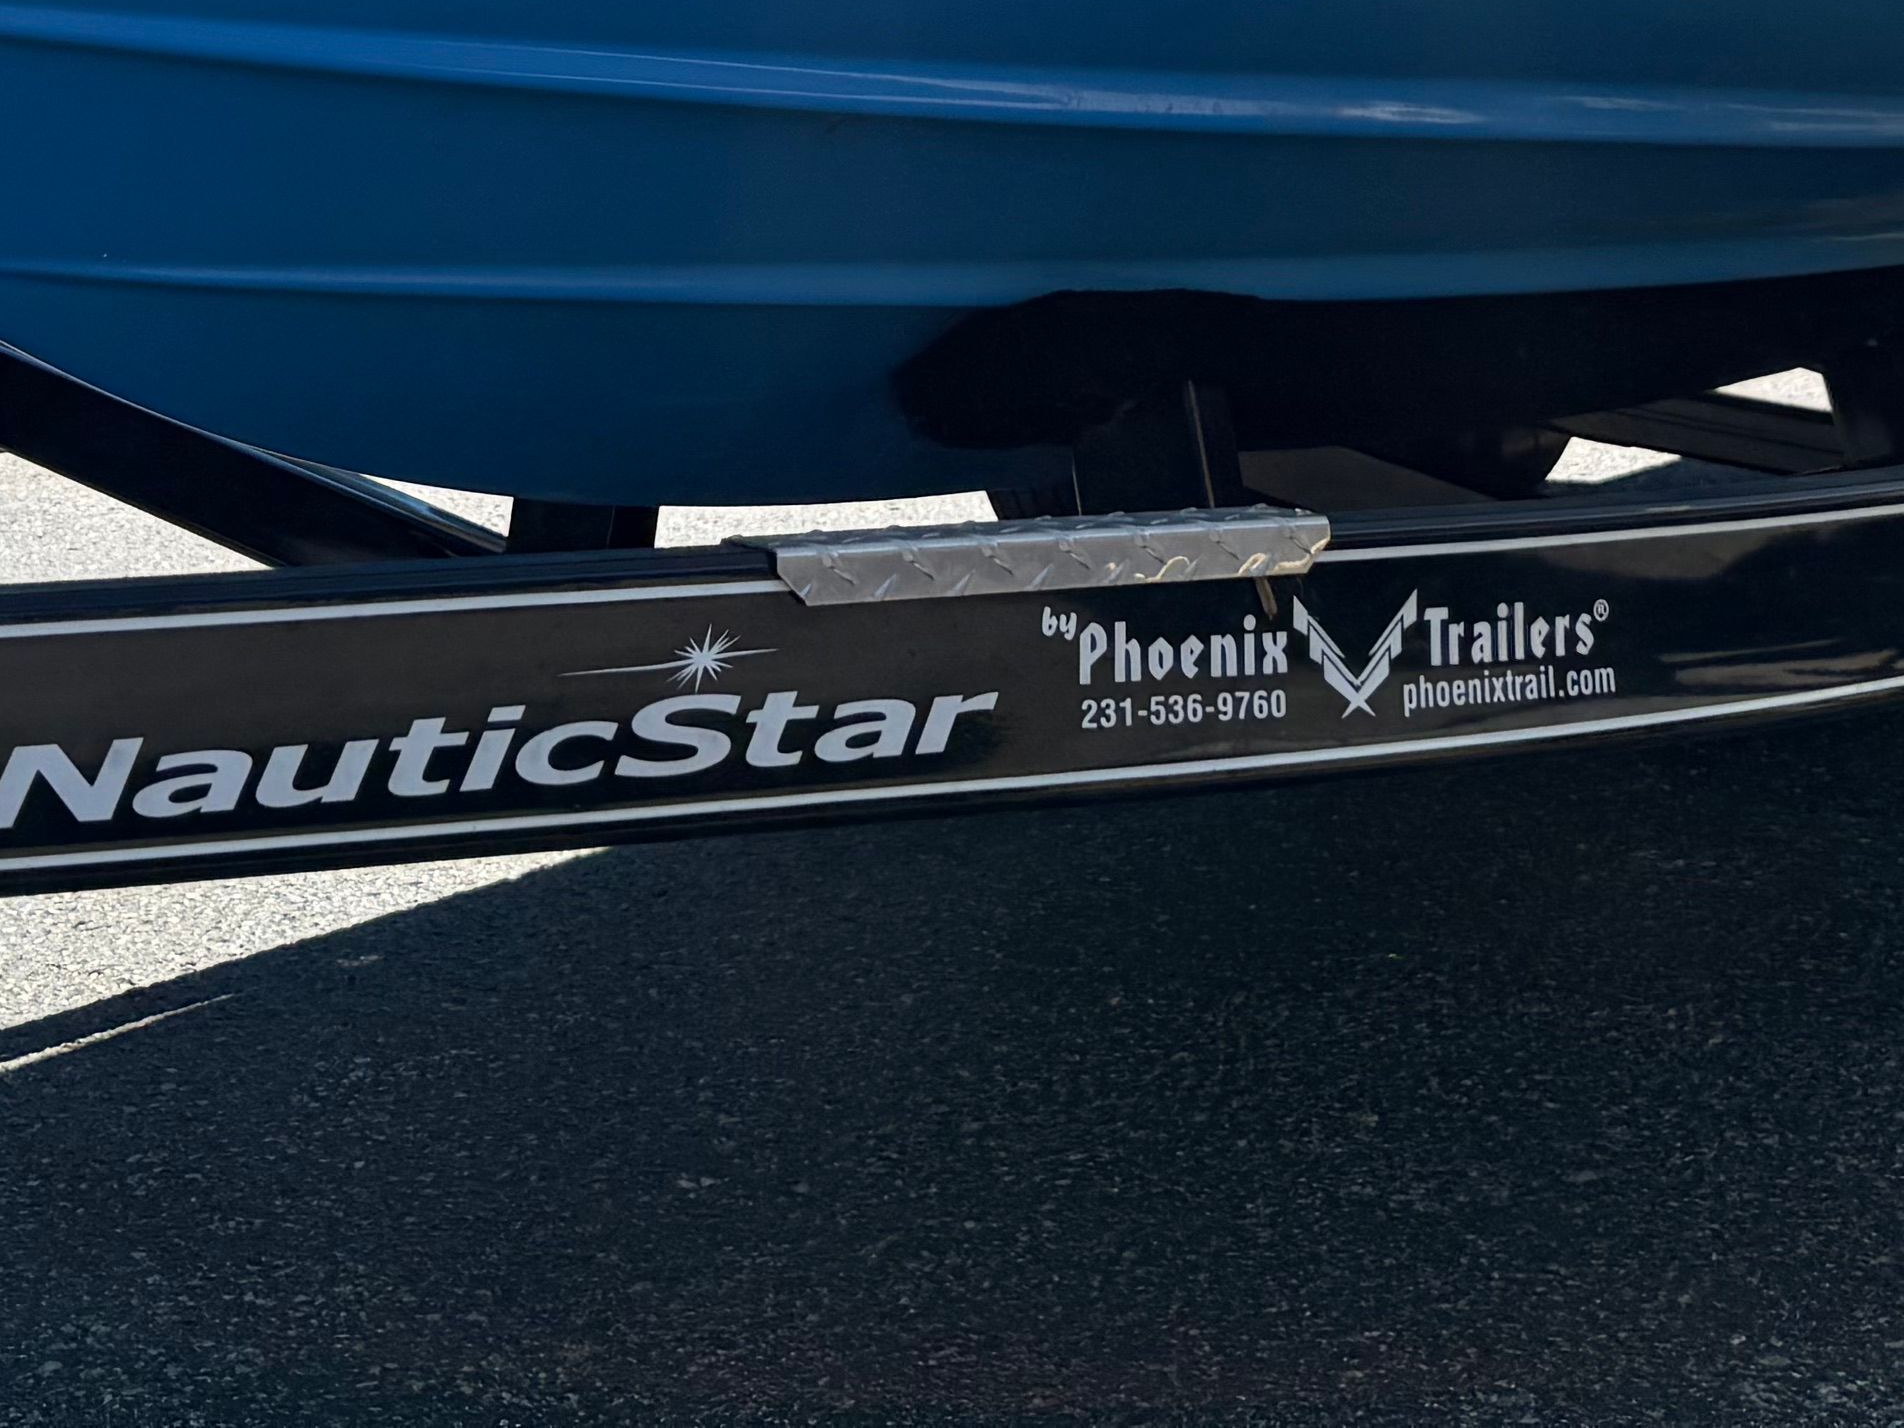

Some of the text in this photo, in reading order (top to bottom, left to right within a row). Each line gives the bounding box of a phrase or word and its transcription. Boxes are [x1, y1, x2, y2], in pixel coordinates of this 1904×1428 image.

[1041, 605, 1077, 641] by
[1078, 614, 1288, 685] Phoenix
[1081, 689, 1288, 729] 231-536-9760
[1402, 663, 1616, 718] phoenixtrail.com
